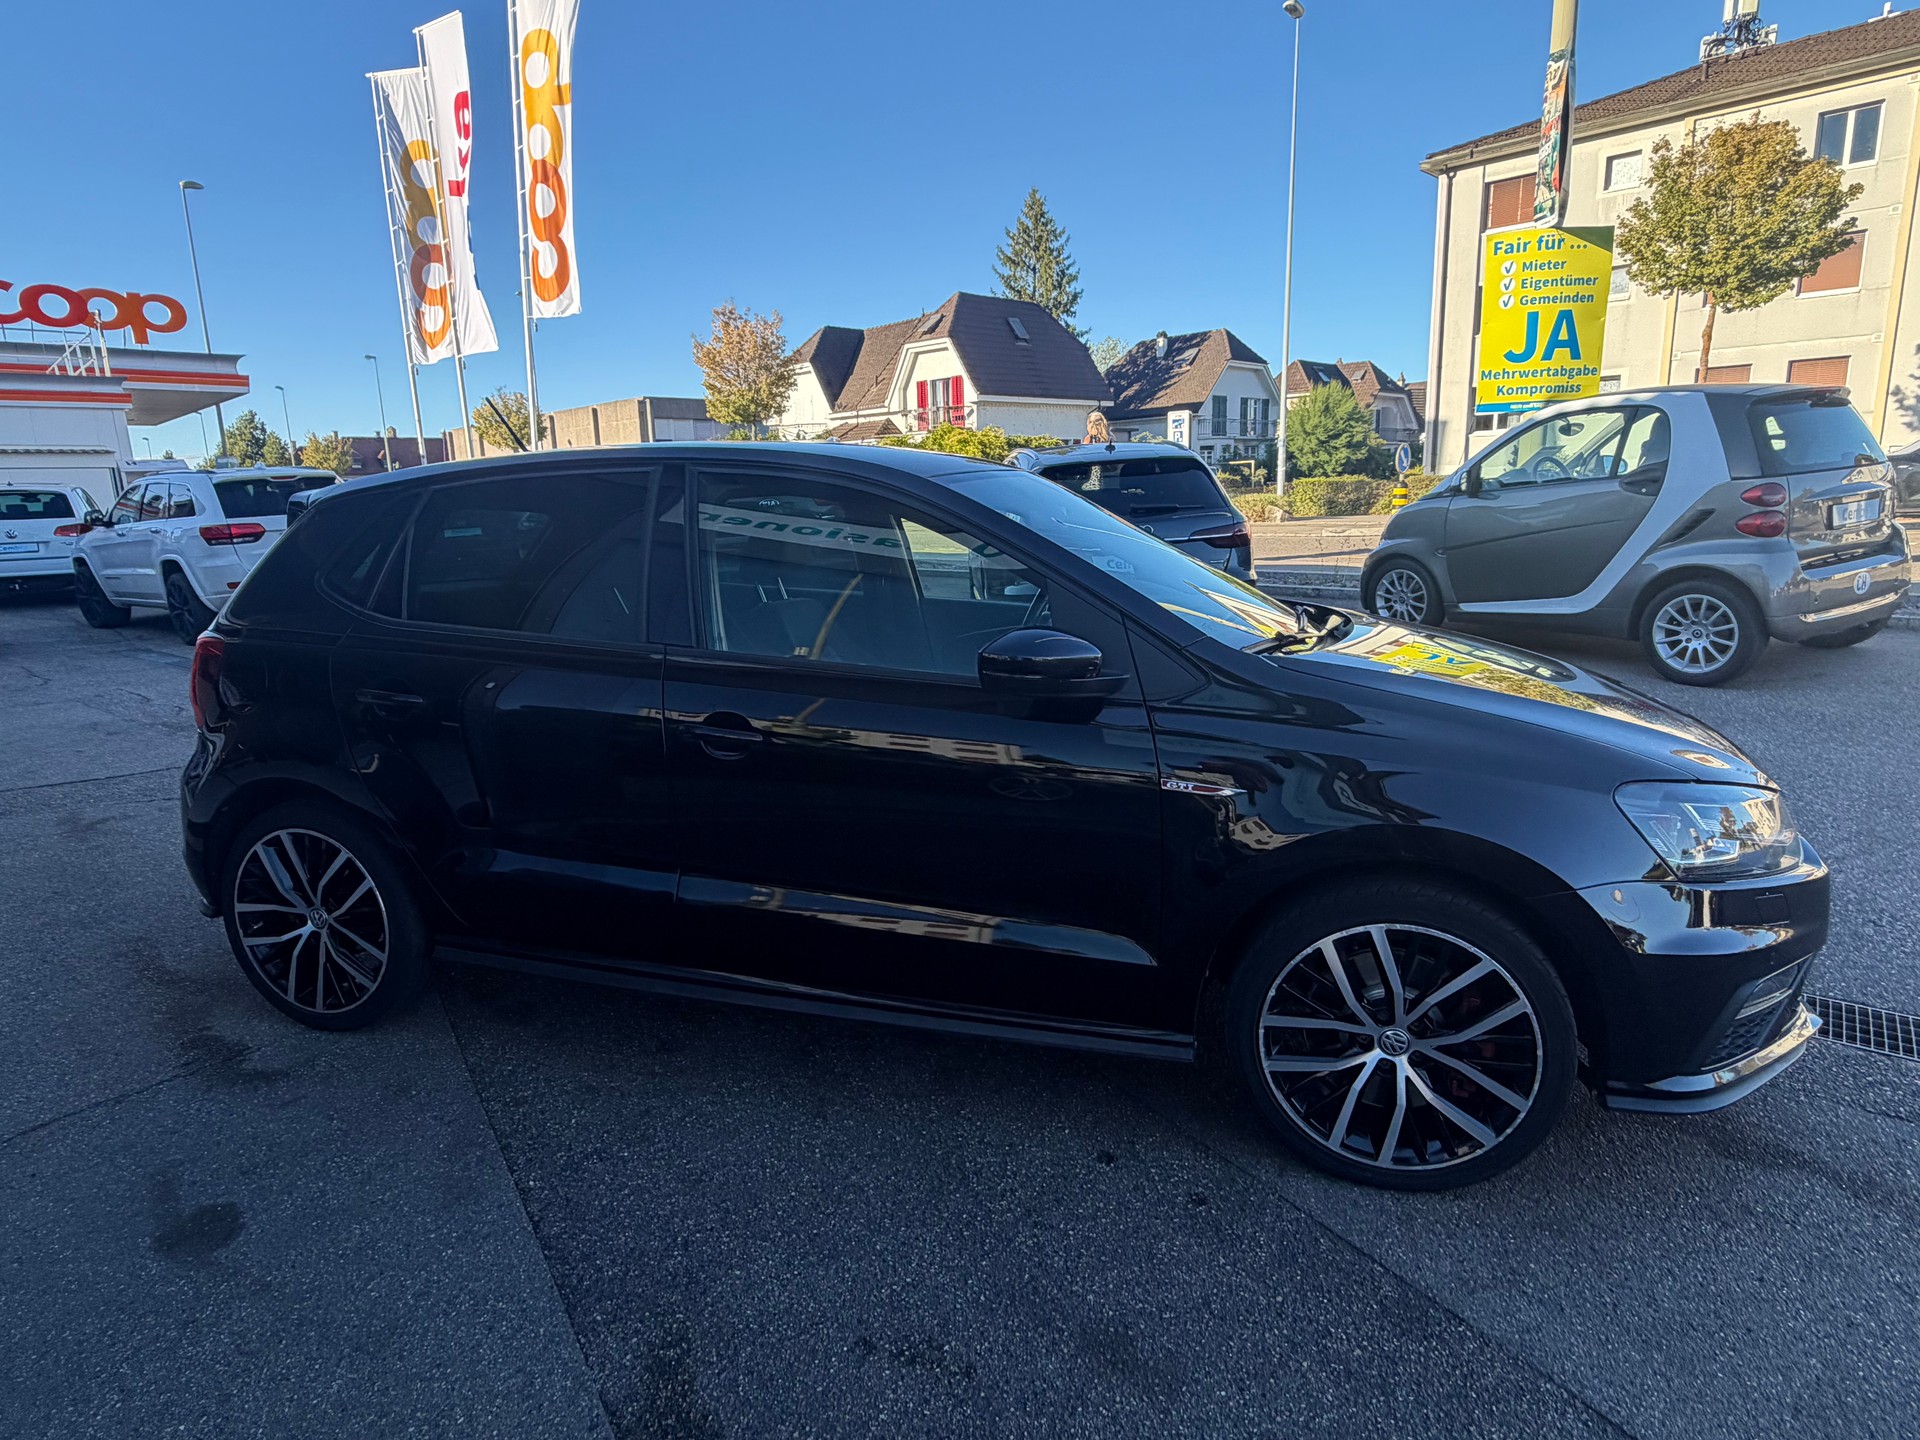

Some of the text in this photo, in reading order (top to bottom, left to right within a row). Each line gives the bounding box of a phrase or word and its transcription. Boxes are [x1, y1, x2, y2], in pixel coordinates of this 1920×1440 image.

[521, 28, 572, 302] coop
[1493, 237, 1531, 256] Fair
[1536, 235, 1565, 251] für
[1522, 259, 1567, 272] Mieter
[1520, 275, 1599, 291] Eigentümer
[1519, 292, 1595, 306] Gemeinden
[1503, 309, 1582, 364] JA
[1481, 364, 1598, 381] Mehrwertabgabe
[1496, 382, 1581, 397] Kompromiss
[1856, 576, 1867, 592] CH
[1166, 781, 1195, 791] GTI
